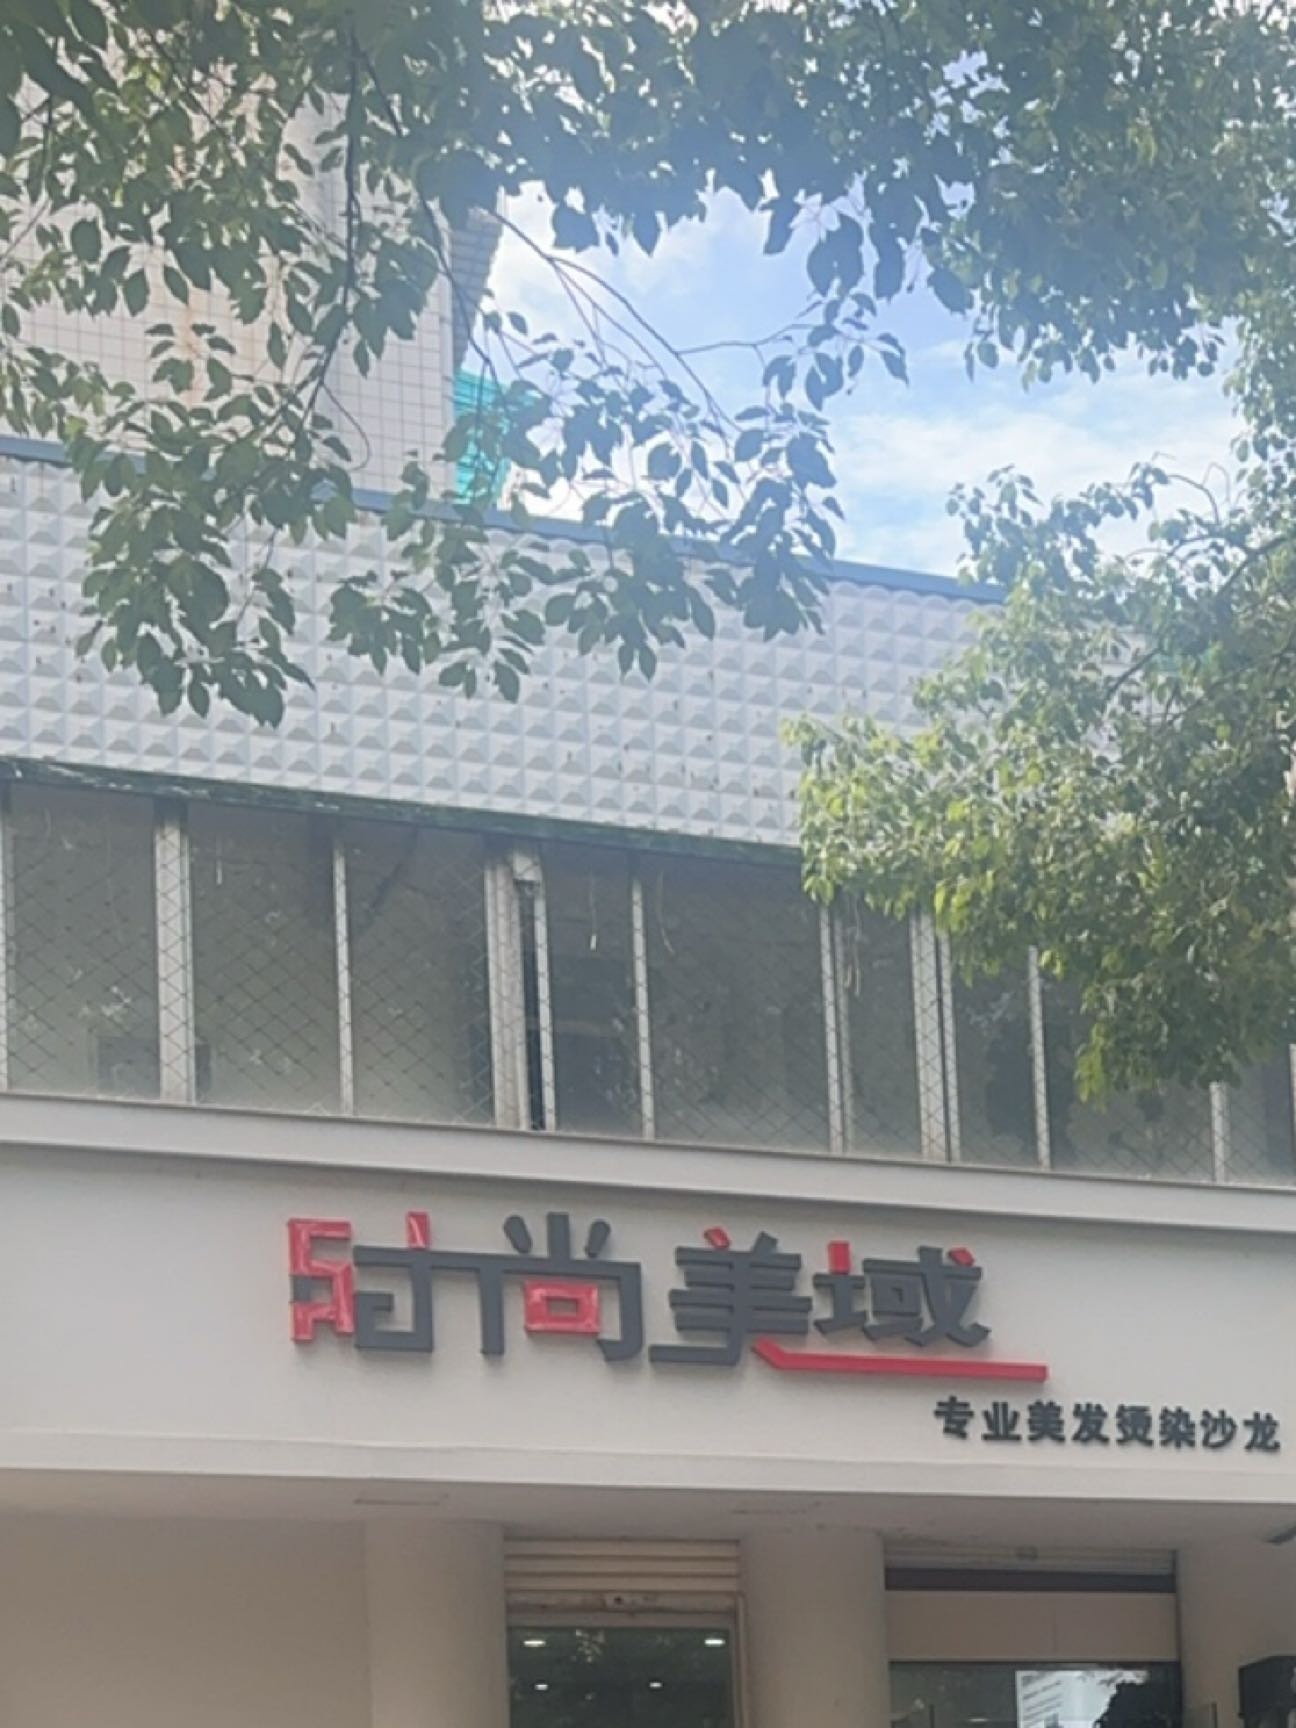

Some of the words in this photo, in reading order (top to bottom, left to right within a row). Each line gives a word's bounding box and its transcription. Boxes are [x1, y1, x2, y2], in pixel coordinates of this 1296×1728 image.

[288, 1210, 1047, 1383] 时尚美域
[934, 1396, 1281, 1452] 专业美发烫染沙龙
